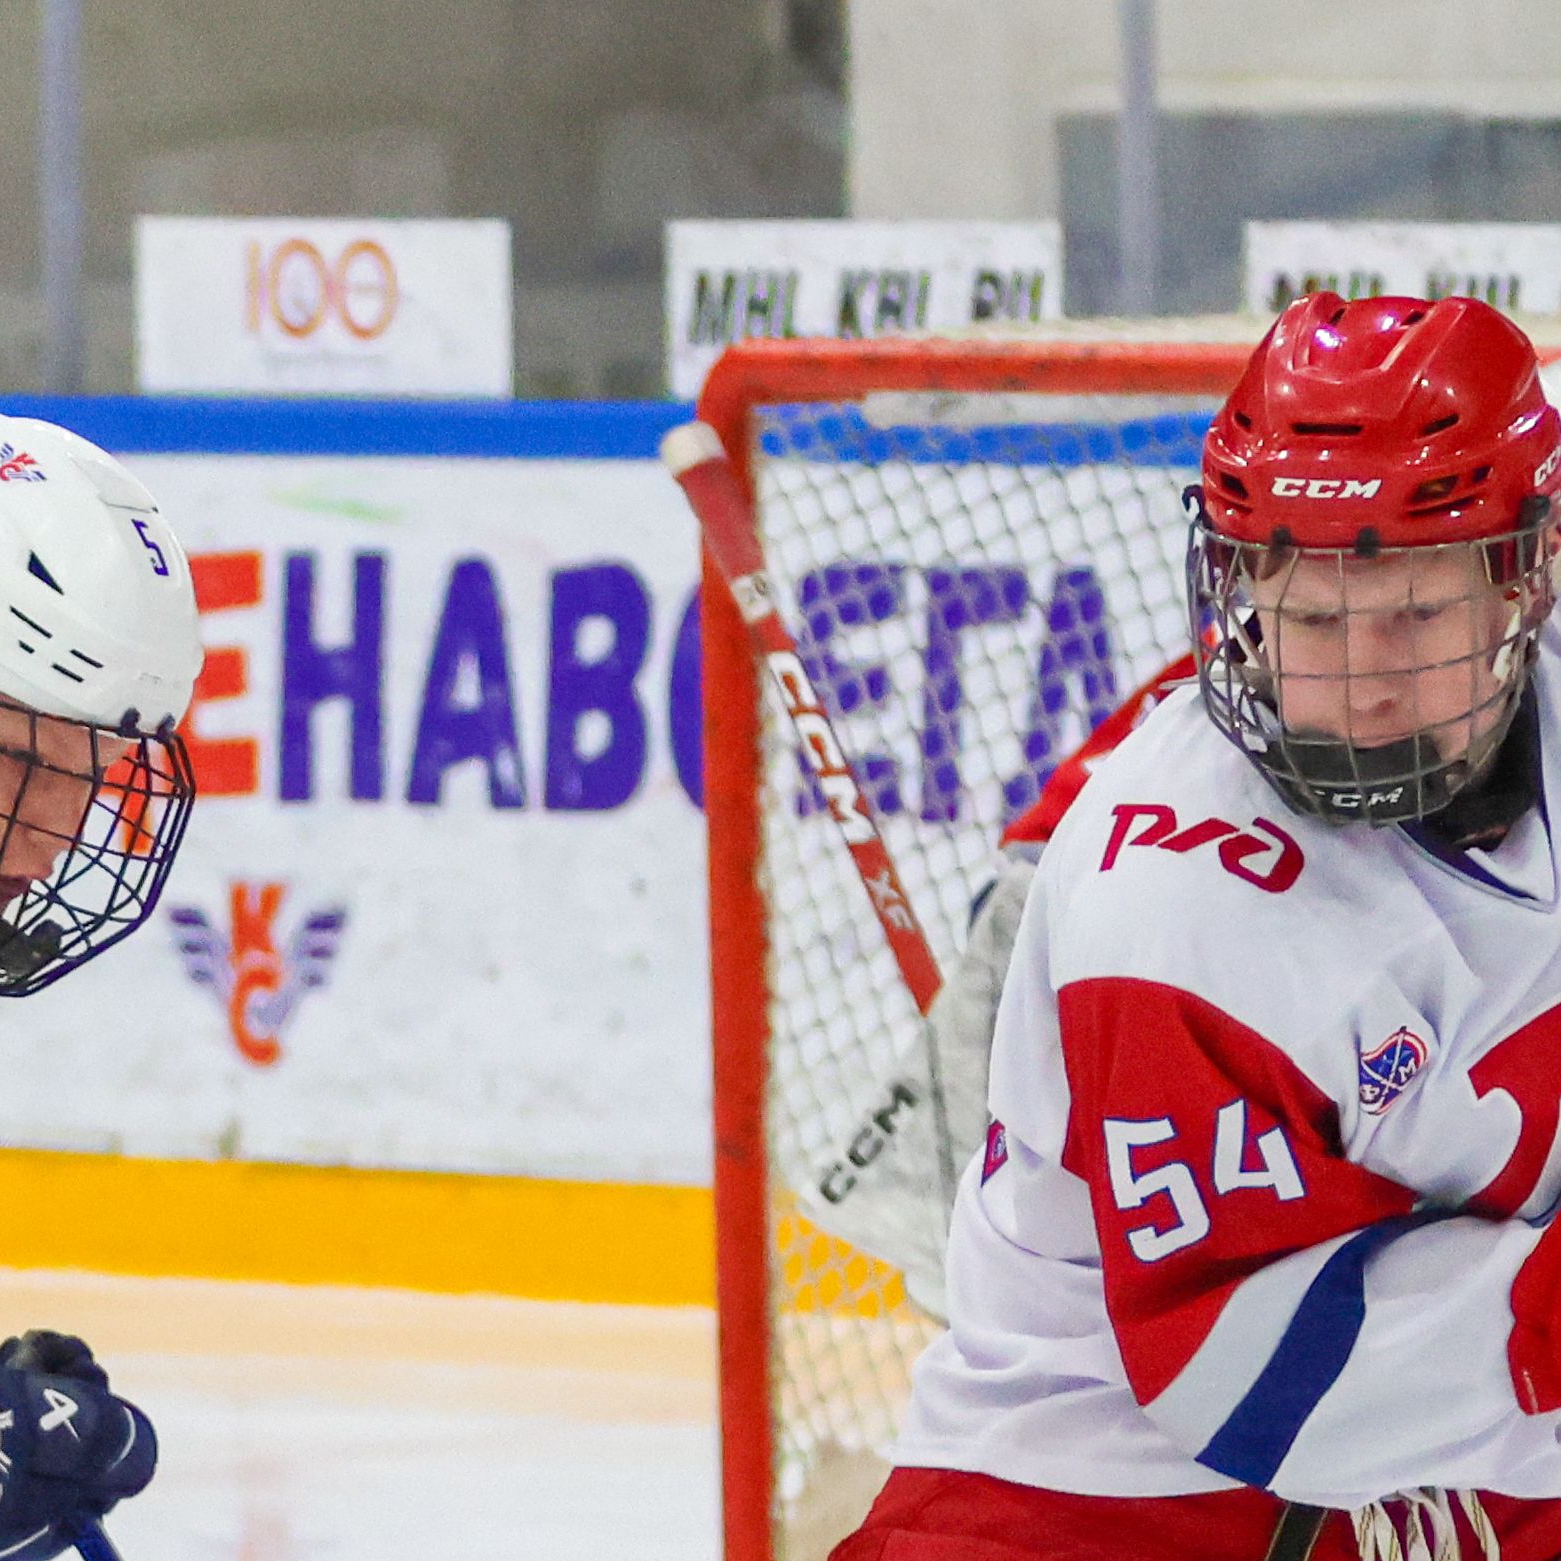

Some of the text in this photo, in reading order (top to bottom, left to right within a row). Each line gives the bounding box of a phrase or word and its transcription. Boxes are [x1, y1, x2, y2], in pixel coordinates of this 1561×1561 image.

[246, 238, 398, 340] 100
[1271, 477, 1382, 499] CCM
[131, 518, 169, 577] 5
[768, 650, 879, 844] CCM
[1315, 786, 1404, 808] CM
[819, 1083, 918, 1204] CCM
[1103, 1098, 1307, 1264] 54
